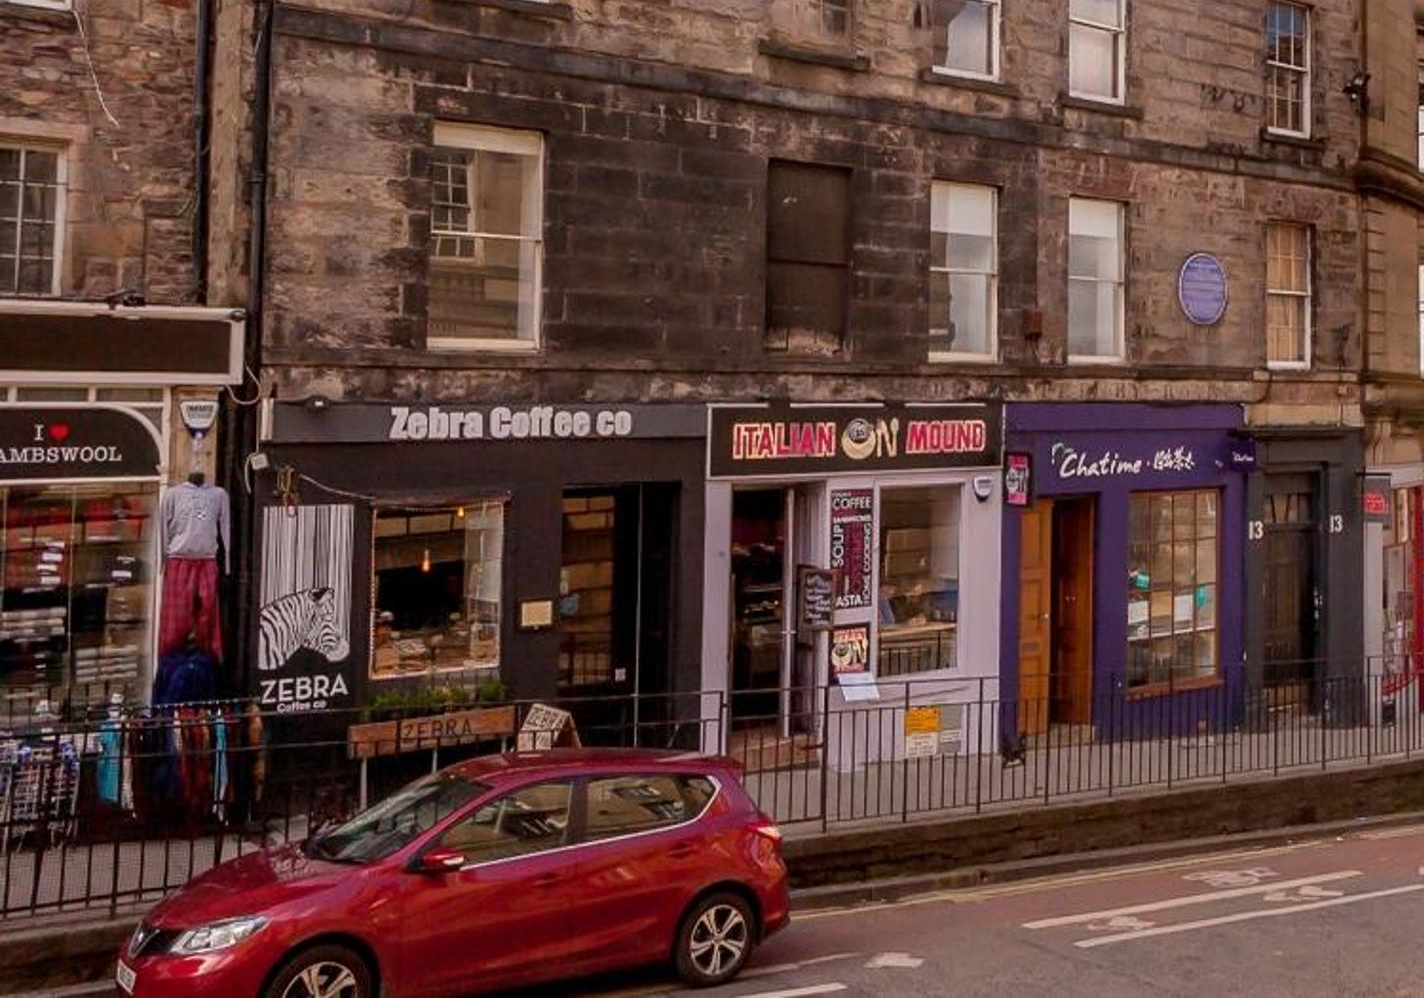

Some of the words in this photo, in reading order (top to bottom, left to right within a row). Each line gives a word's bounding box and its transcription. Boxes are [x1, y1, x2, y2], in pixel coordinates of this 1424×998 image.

[33, 424, 44, 441] I
[389, 406, 484, 440] Zebra
[489, 404, 591, 439] Coffee
[596, 410, 633, 437] co
[732, 421, 837, 460] ITALIAN
[841, 417, 899, 460] ON
[905, 419, 987, 455] MOUND
[1059, 452, 1142, 479] Chatime
[832, 496, 871, 511] COFFEE
[1248, 520, 1265, 540] 13
[1328, 514, 1344, 534] 13
[832, 523, 845, 568] SOUP
[834, 593, 863, 608] ASTA
[260, 673, 349, 705] ZEBRA
